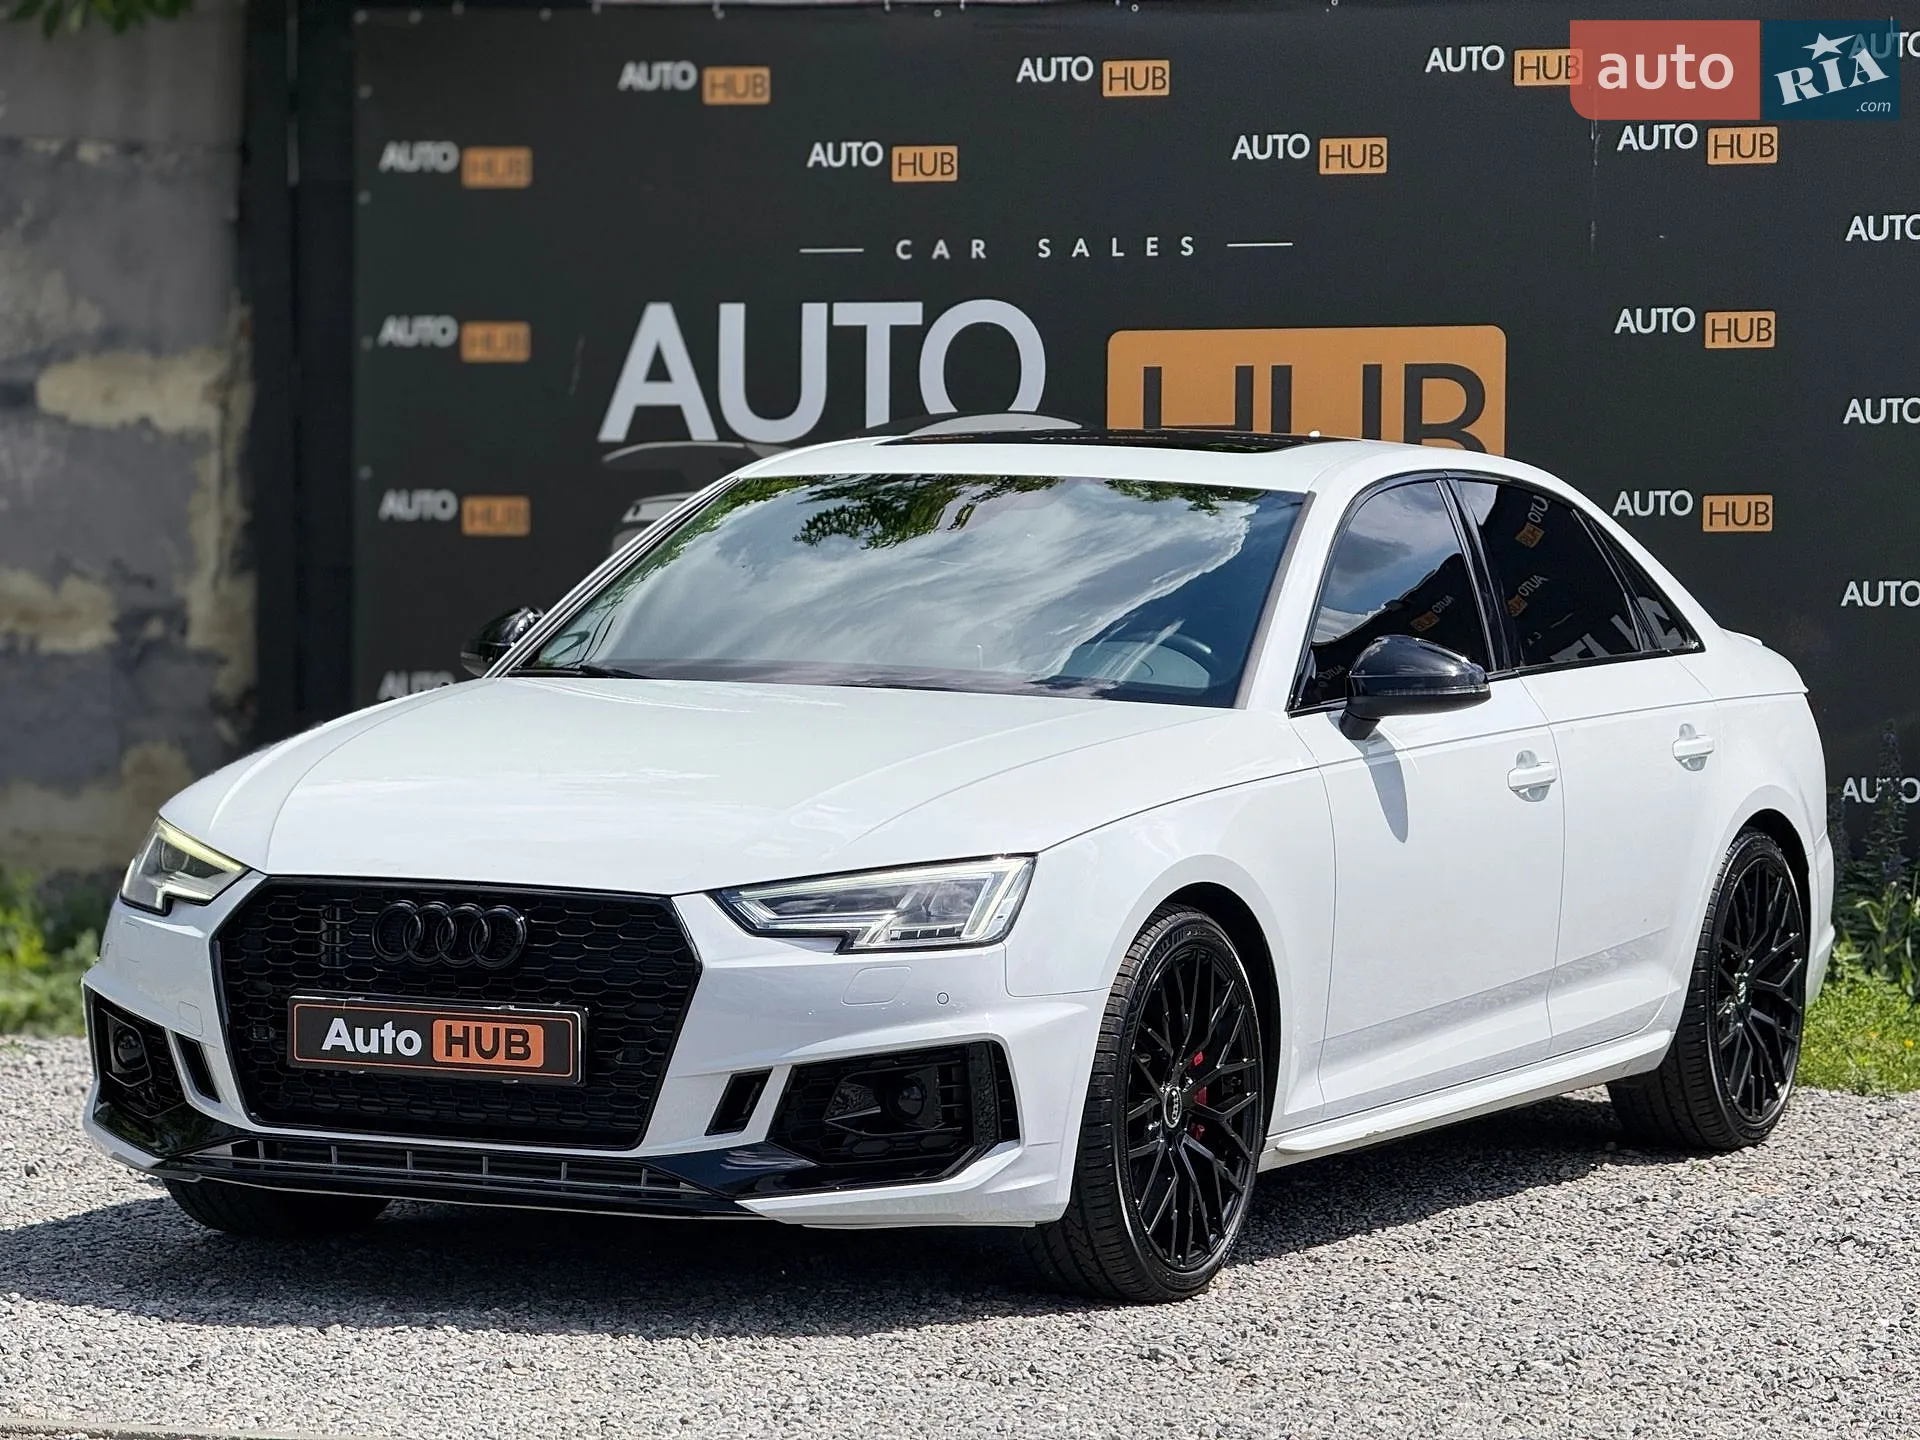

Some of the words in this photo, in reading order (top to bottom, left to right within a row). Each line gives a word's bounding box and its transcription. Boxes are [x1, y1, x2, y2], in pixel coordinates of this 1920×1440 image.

[618, 60, 698, 91] AUTO
[709, 73, 767, 99] HUB
[1016, 56, 1094, 83] AUTO
[1108, 65, 1167, 91] HUB
[1425, 45, 1505, 73] AUTO
[1520, 55, 1581, 81] HUB
[379, 141, 460, 173] AUTO
[806, 141, 884, 168] AUTO
[898, 151, 956, 177] HUB
[1232, 133, 1311, 160] AUTO
[1325, 143, 1385, 169] HUB
[1616, 123, 1699, 151] AUTO
[1713, 133, 1775, 160] HUB
[896, 239, 987, 260] CAR
[1038, 236, 1194, 258] SALES
[378, 315, 458, 347] AUTO
[1614, 306, 1696, 334] AUTO
[1711, 318, 1772, 343] HUB
[598, 299, 1047, 443] AUTO
[1843, 397, 1920, 425] AUTO
[379, 488, 458, 521] AUTO
[1612, 490, 1694, 518] AUTO
[1709, 501, 1770, 527] HUB
[1840, 580, 1920, 608] AUTO
[1840, 777, 1920, 804] AUO
[321, 1017, 423, 1058] Auto
[445, 1023, 531, 1062] HUB
